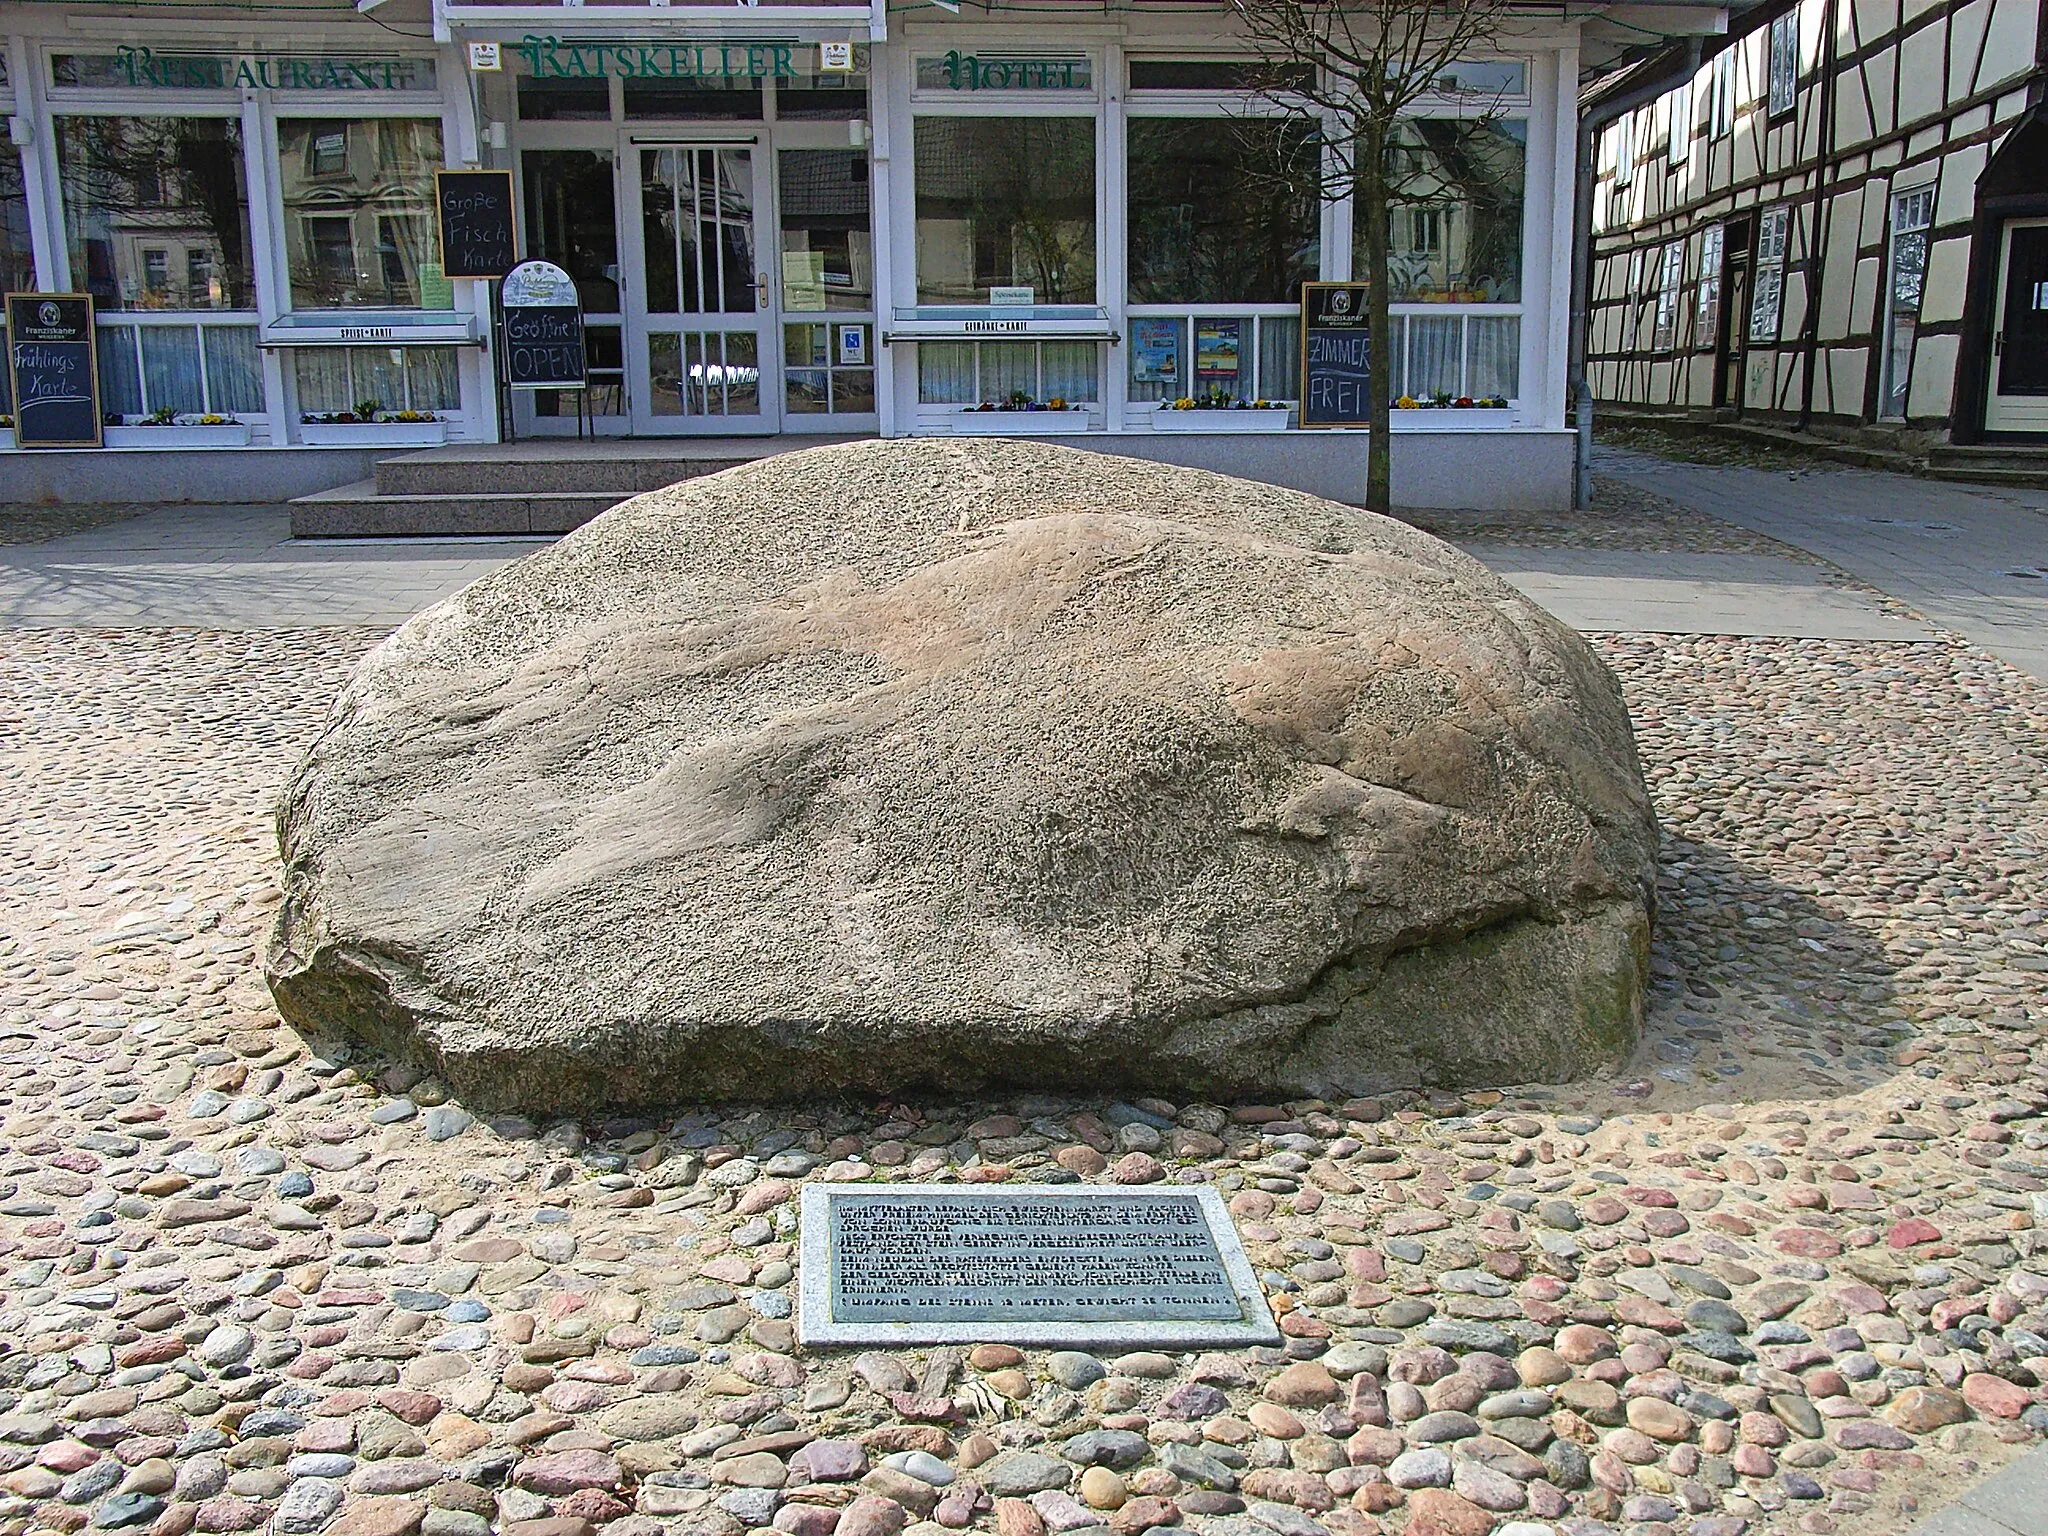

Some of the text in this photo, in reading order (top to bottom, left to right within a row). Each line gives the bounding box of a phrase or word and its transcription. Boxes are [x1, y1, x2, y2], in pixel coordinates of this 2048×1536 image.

[117, 45, 403, 91] RESTAURANT
[518, 34, 798, 79] RATSKELLER
[943, 49, 1088, 92] HOTEL
[448, 211, 508, 247] Fisch
[25, 326, 77, 335] Franziskaner
[1318, 314, 1364, 323] Franziskaner
[14, 343, 76, 374] Frühlings
[513, 347, 581, 378] OPEN
[1308, 335, 1371, 370] ZIMMER
[30, 374, 78, 397] Karte
[1309, 377, 1361, 416] FREI
[840, 1278, 876, 1286] EINEN
[1111, 1270, 1154, 1278] DIESER
[1157, 1270, 1198, 1278] STELLE
